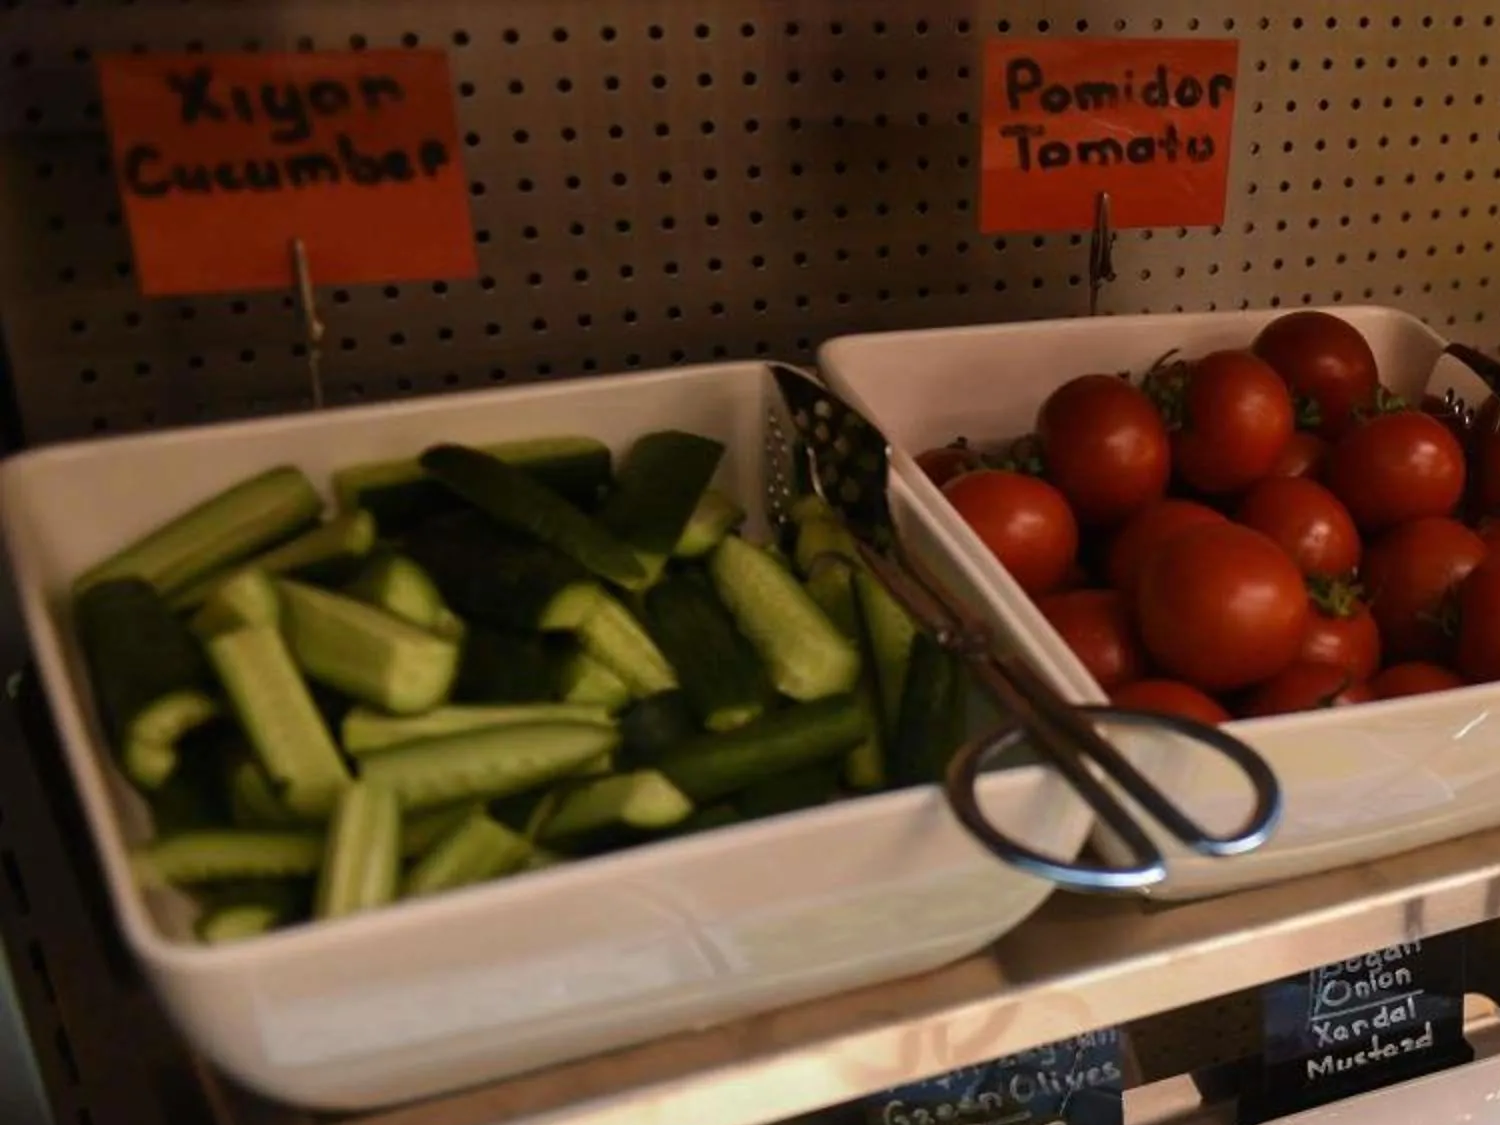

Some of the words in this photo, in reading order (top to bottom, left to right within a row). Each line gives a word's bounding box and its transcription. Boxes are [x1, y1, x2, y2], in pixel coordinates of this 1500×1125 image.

[1005, 57, 1234, 113] Pomidor
[123, 134, 450, 196] Cucumber
[999, 121, 1215, 173] Tomato
[1322, 966, 1412, 1006] Onion
[1312, 996, 1416, 1048] Xardal
[1009, 1060, 1121, 1104] Olives
